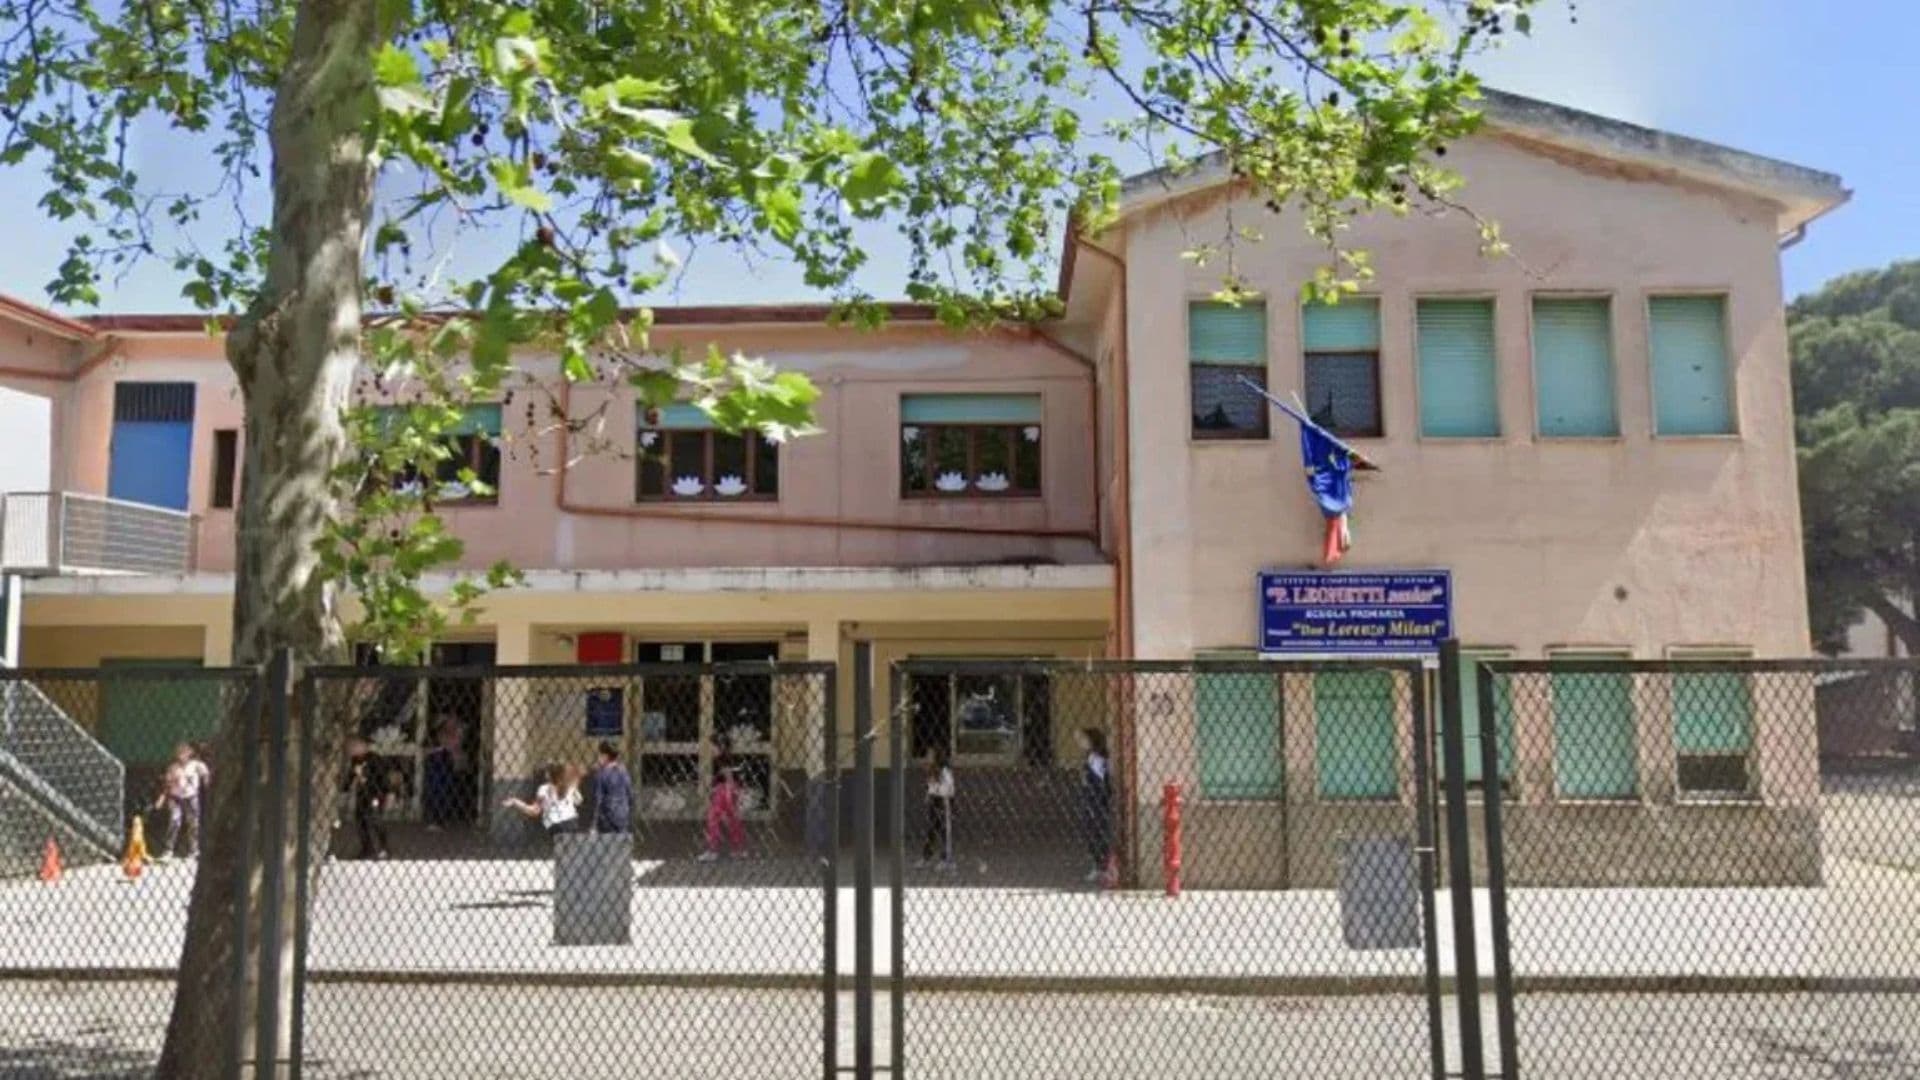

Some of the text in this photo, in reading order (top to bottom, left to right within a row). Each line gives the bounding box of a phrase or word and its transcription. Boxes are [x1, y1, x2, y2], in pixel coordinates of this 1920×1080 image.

[1293, 587, 1385, 604] LEONETTI
[1305, 610, 1405, 619] SCUOLA PRIMARIA
[1328, 620, 1385, 637] Lorenzo
